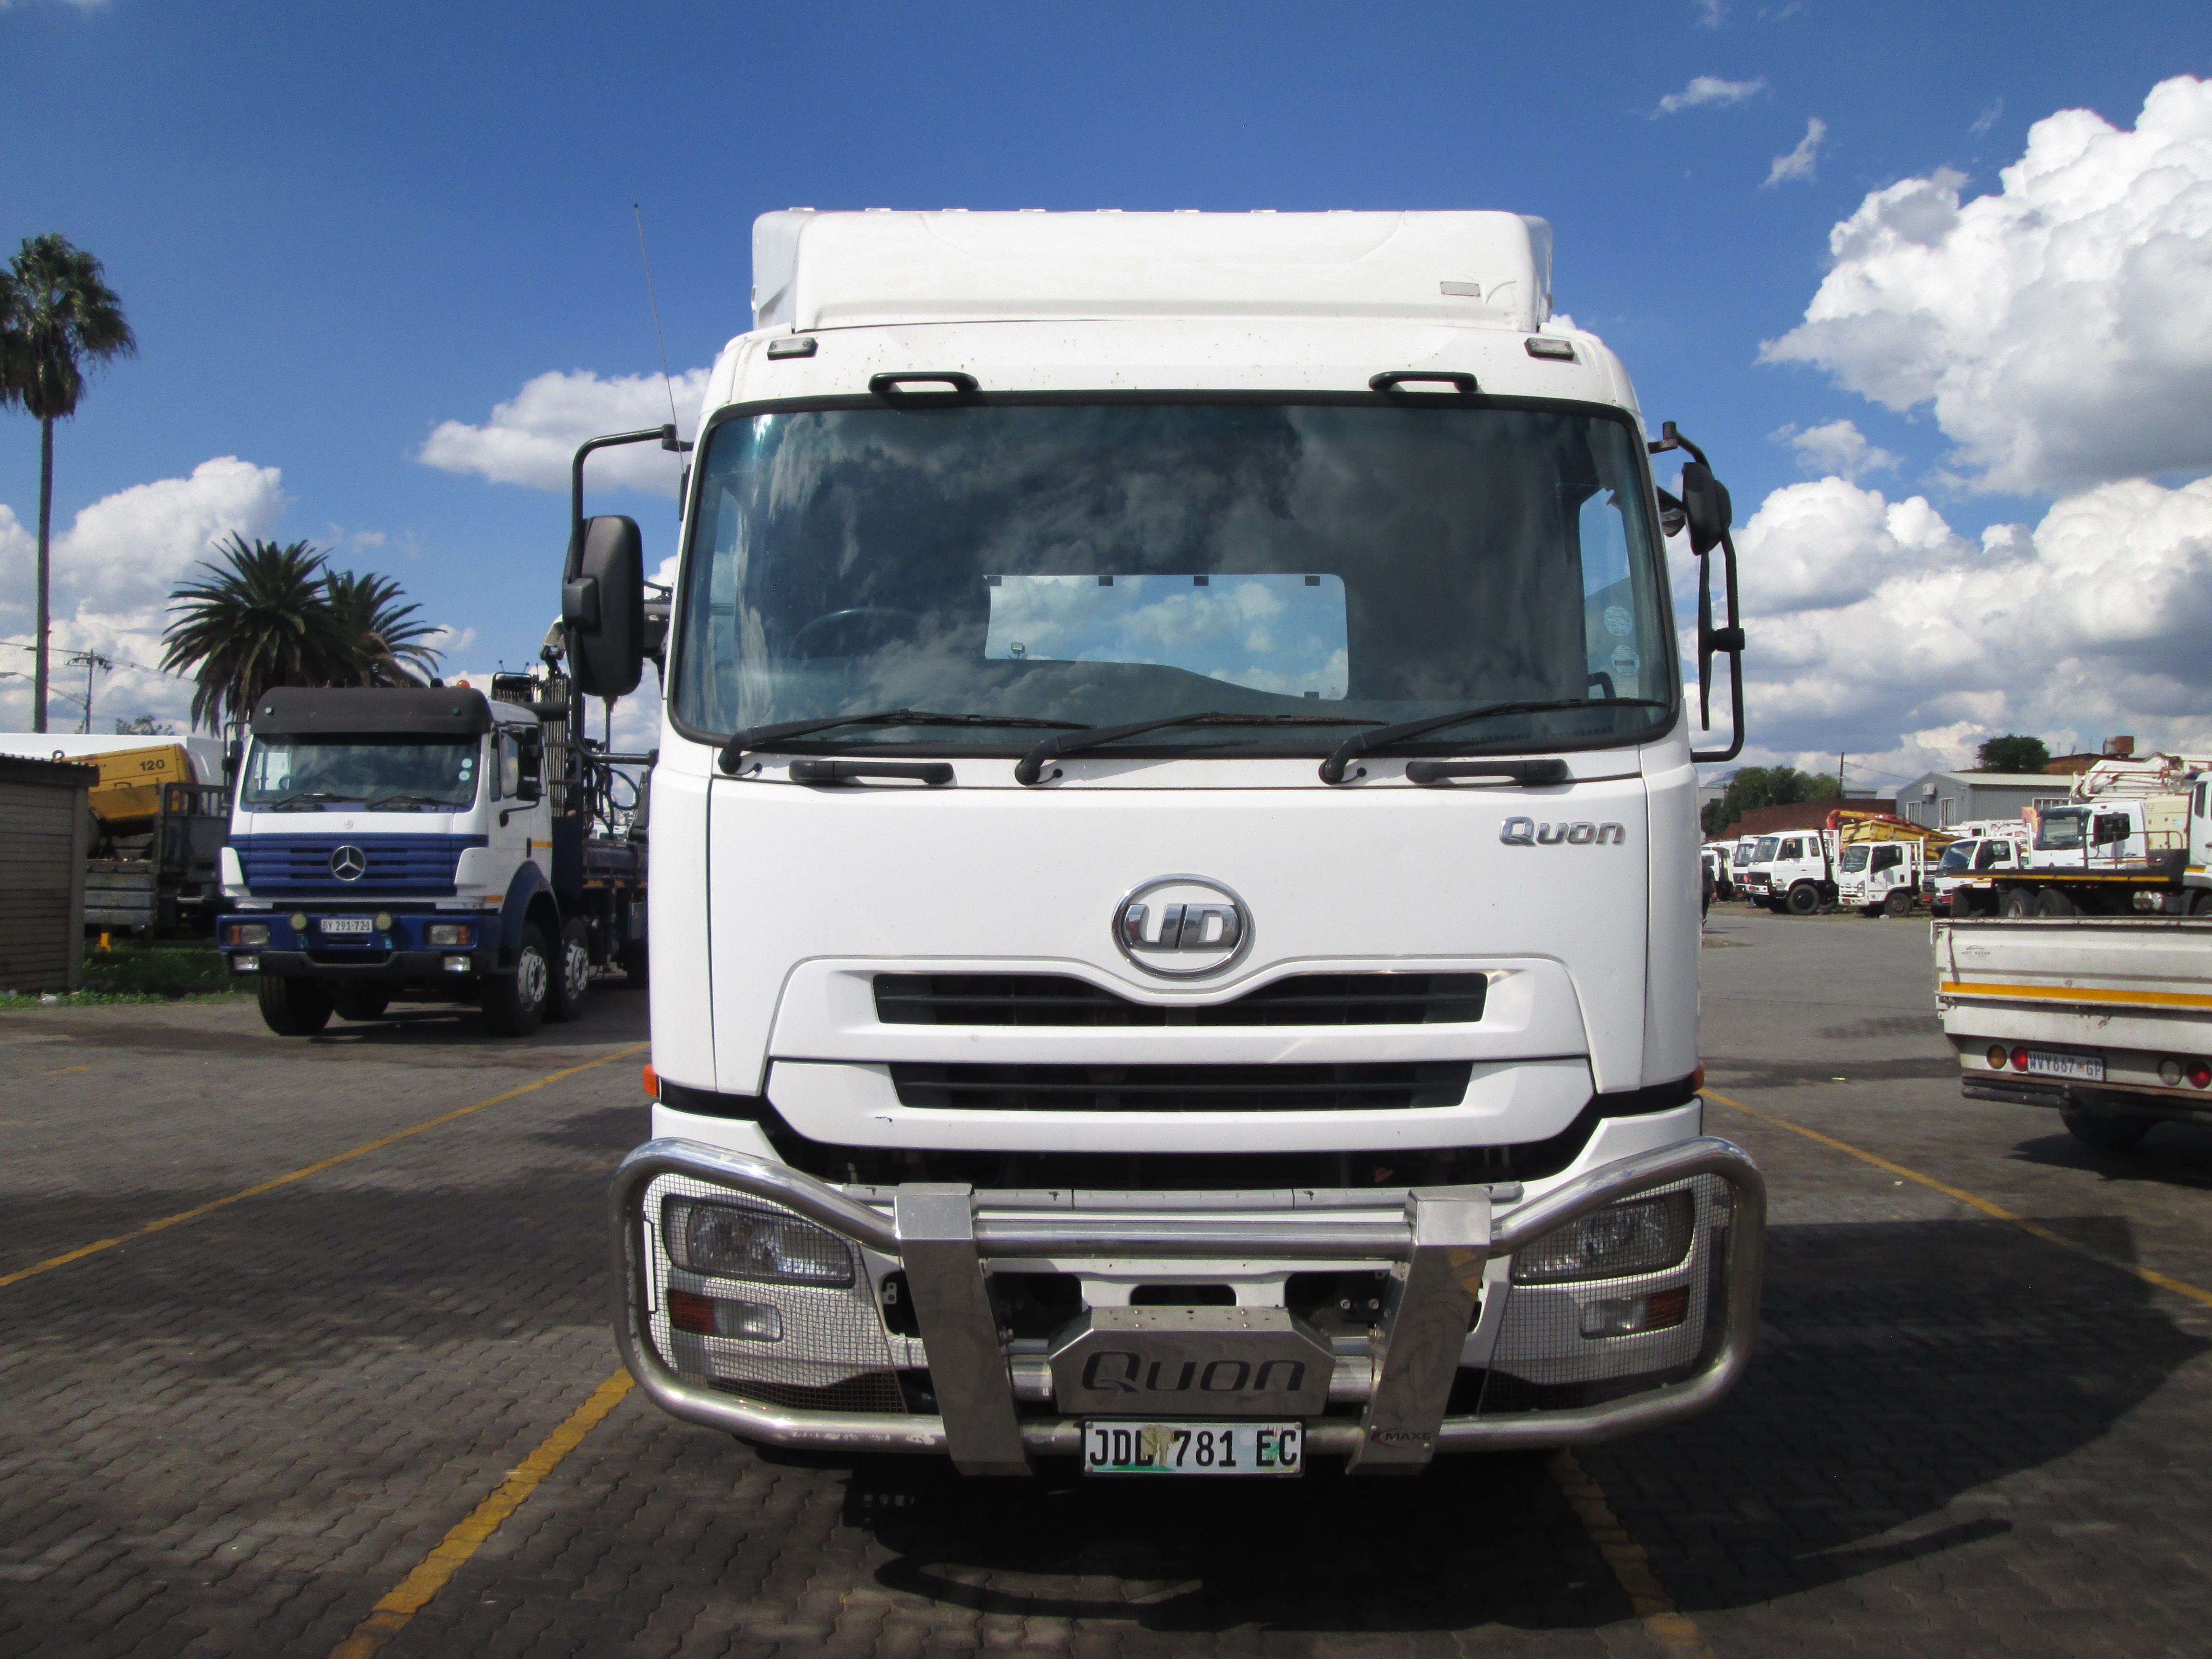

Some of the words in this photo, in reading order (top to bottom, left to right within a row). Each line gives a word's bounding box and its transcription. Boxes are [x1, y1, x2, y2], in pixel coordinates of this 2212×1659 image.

[139, 759, 165, 771] 120
[1124, 903, 1239, 949] UD
[2086, 1059, 2101, 1076] GP
[1090, 1429, 1154, 1466] JDL
[1174, 1430, 1237, 1467] 781
[1256, 1430, 1297, 1467] EC
